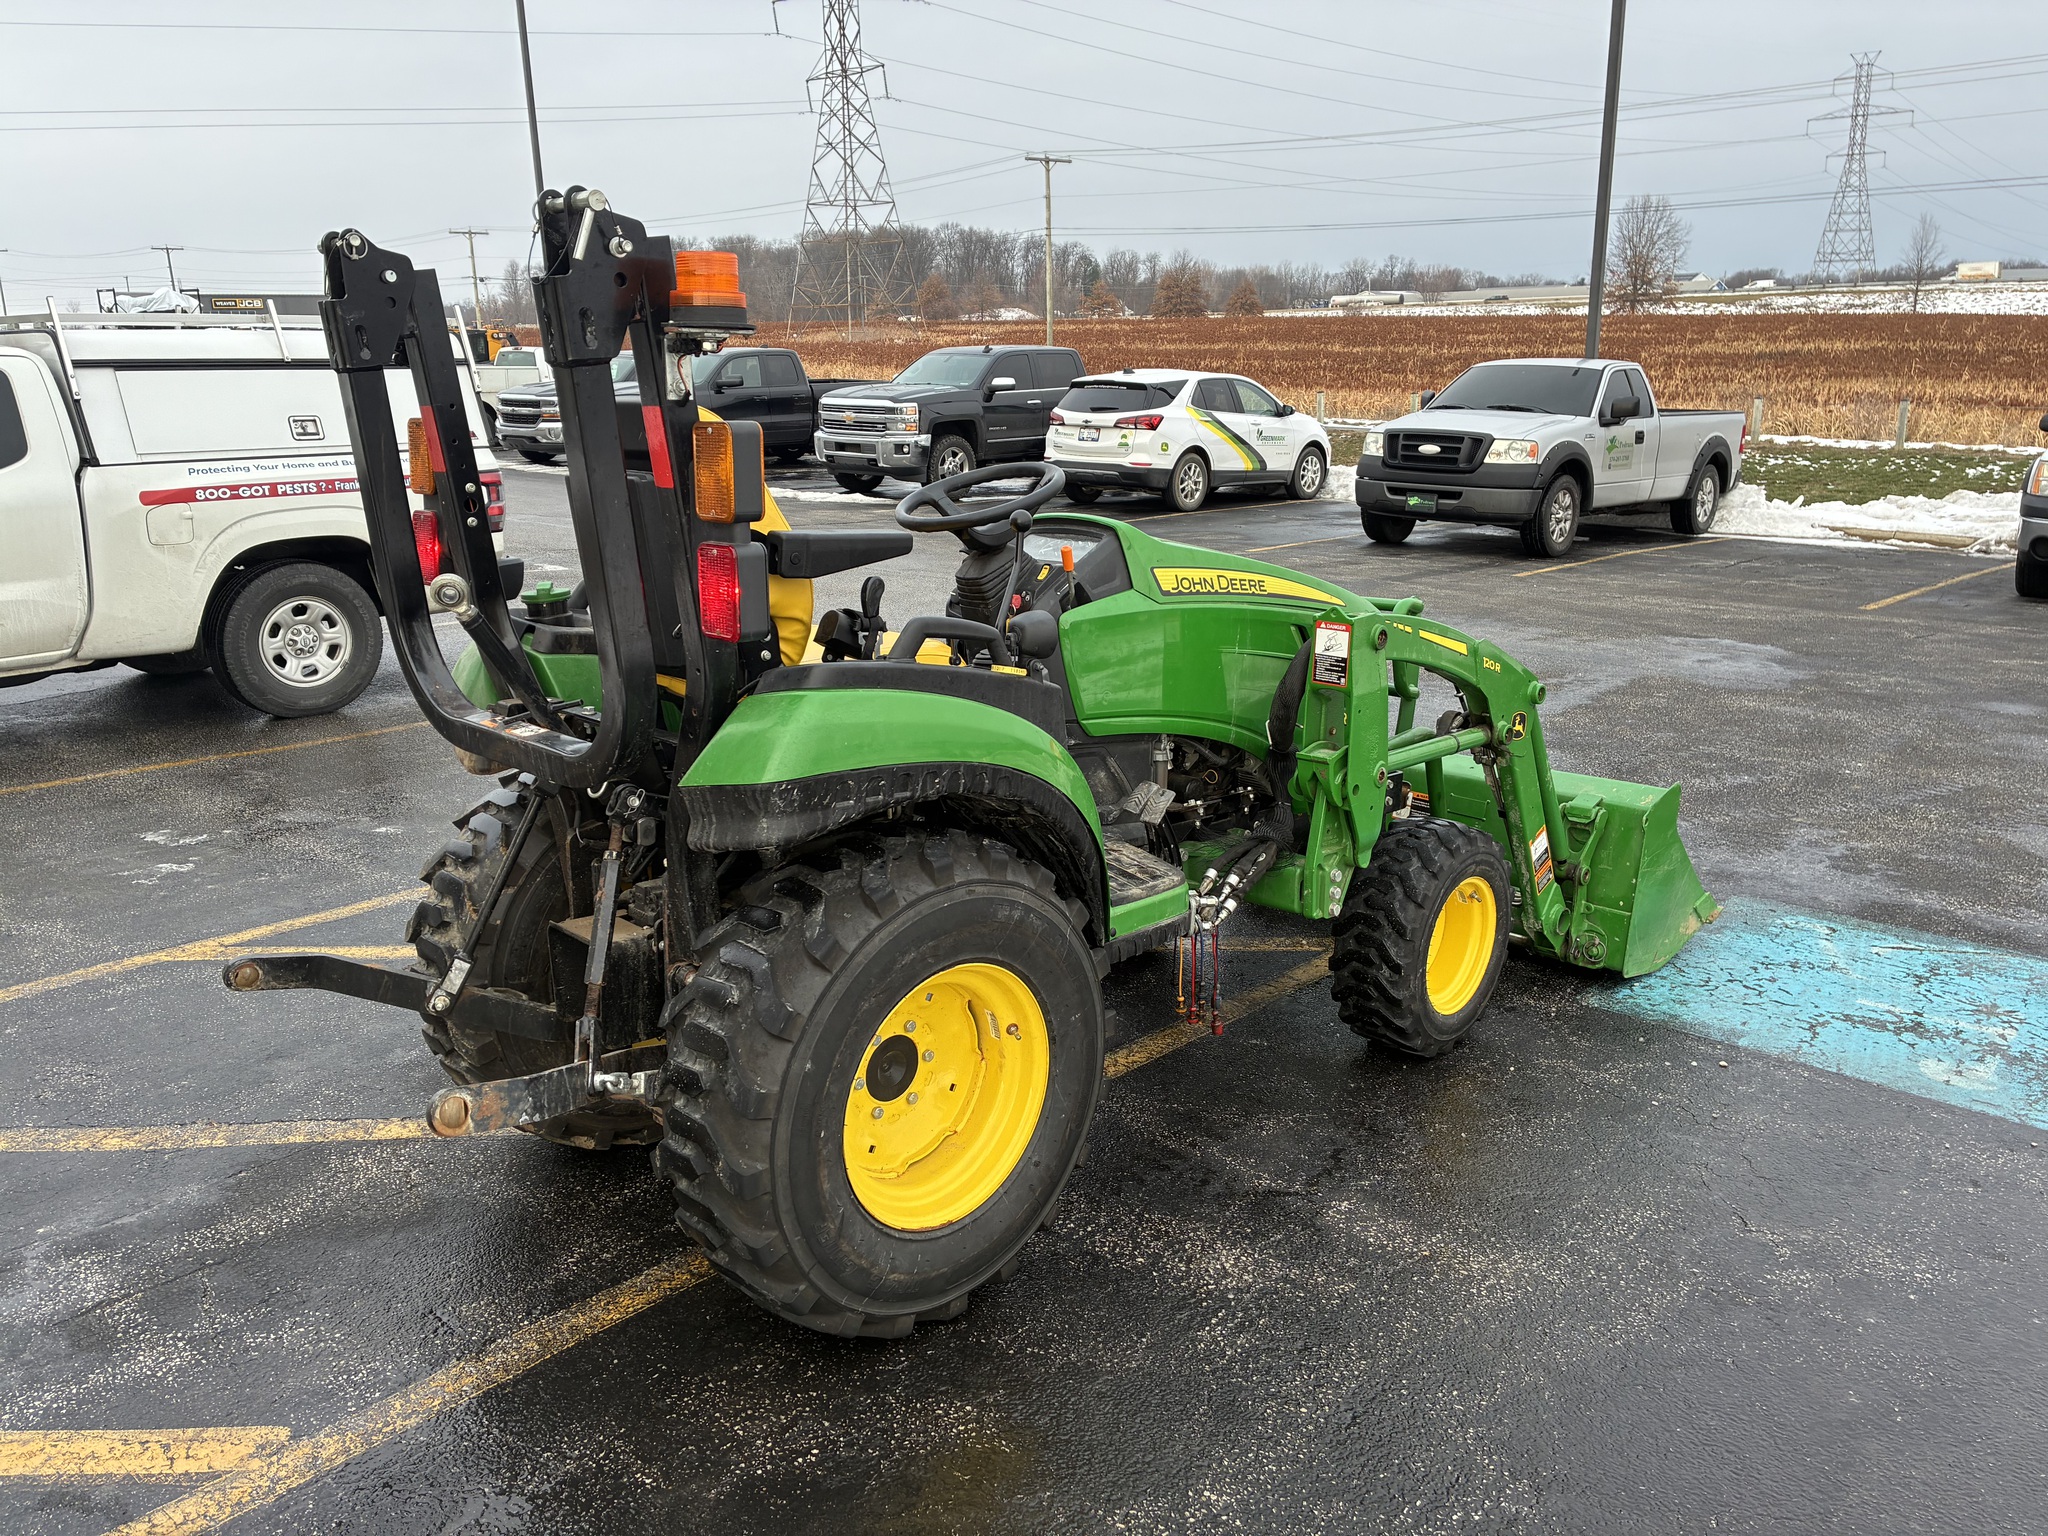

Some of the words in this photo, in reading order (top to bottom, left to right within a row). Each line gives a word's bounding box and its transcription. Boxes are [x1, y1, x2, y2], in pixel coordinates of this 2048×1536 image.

[188, 465, 250, 476] Protecting
[253, 463, 279, 471] Your
[282, 461, 314, 469] Home
[315, 459, 339, 467] and
[195, 485, 271, 500] 800-GOT
[1171, 574, 1215, 591] JOHN
[1216, 575, 1268, 592] DEERE
[1326, 623, 1347, 631] DANGER
